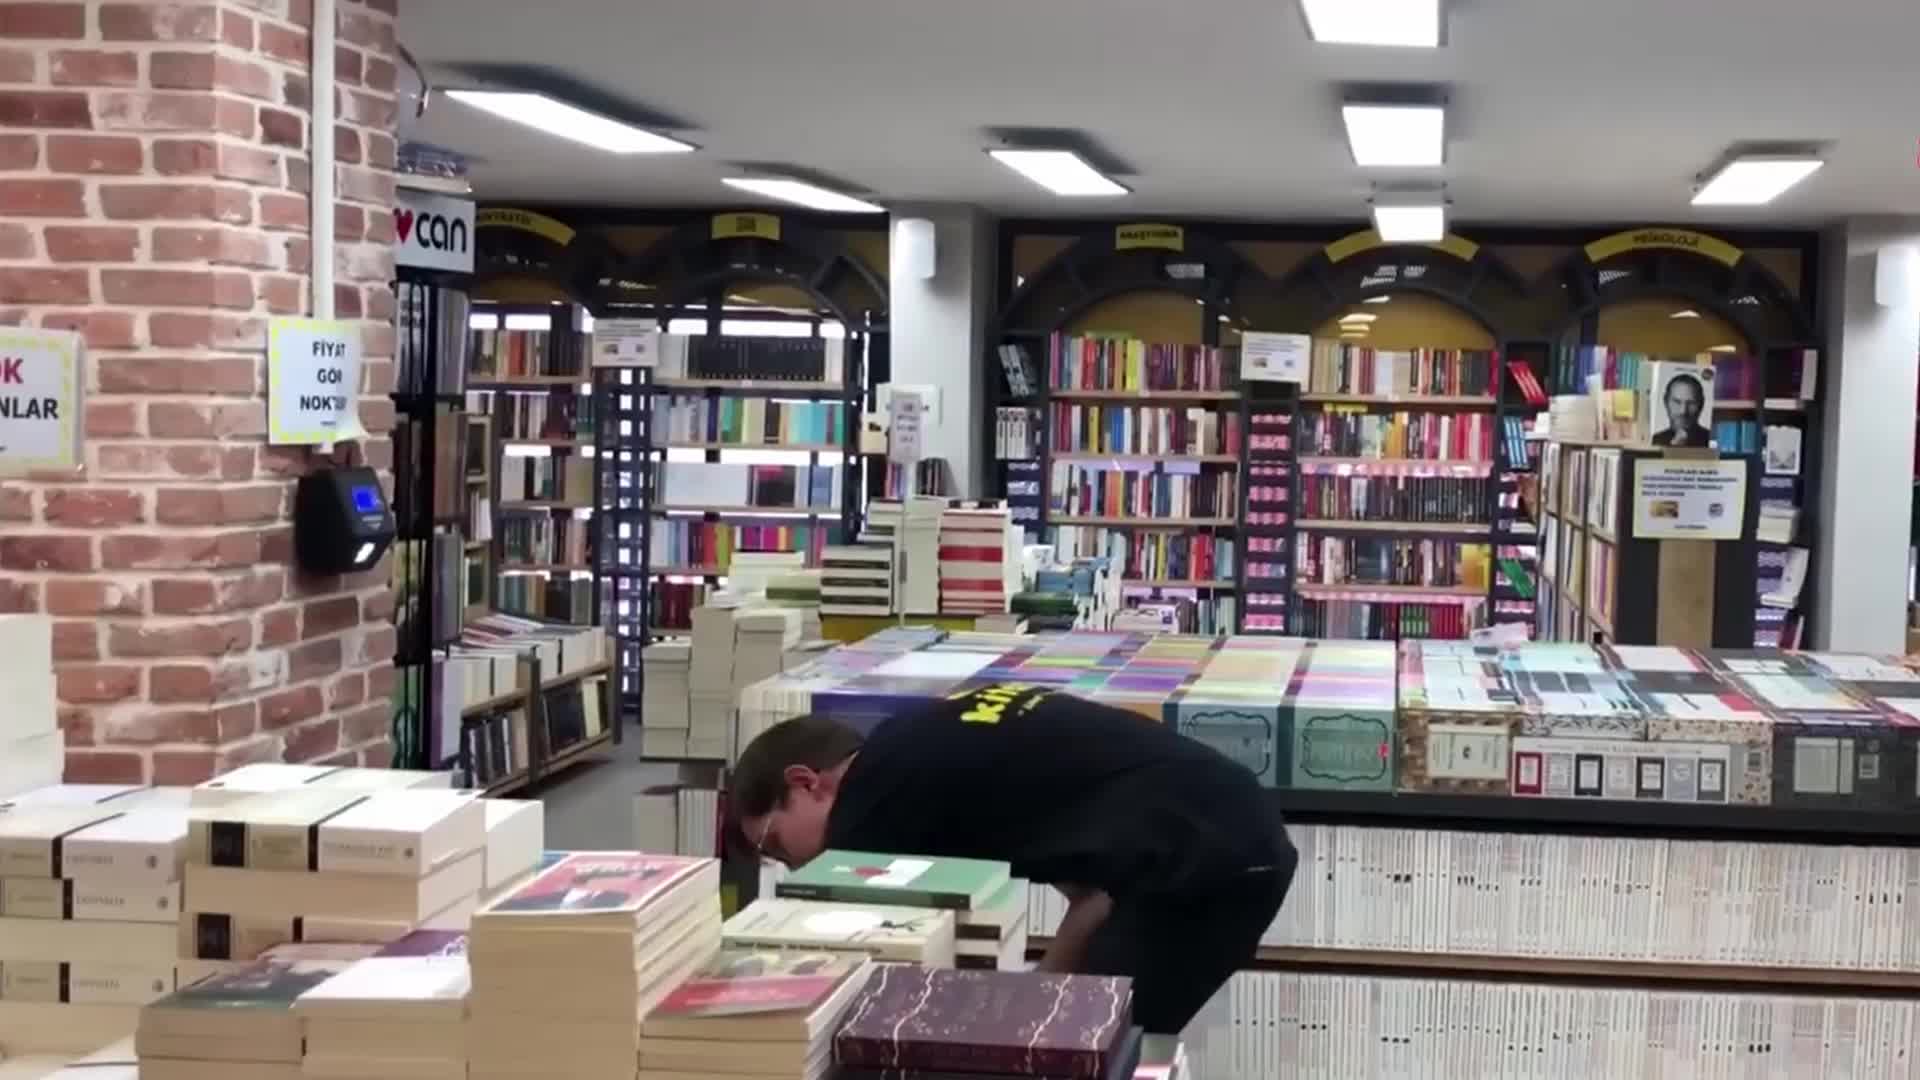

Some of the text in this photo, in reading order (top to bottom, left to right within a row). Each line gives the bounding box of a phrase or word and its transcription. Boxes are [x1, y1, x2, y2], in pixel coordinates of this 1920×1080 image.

[415, 211, 467, 253] can
[312, 339, 346, 358] FİYAT
[0, 357, 24, 384] K
